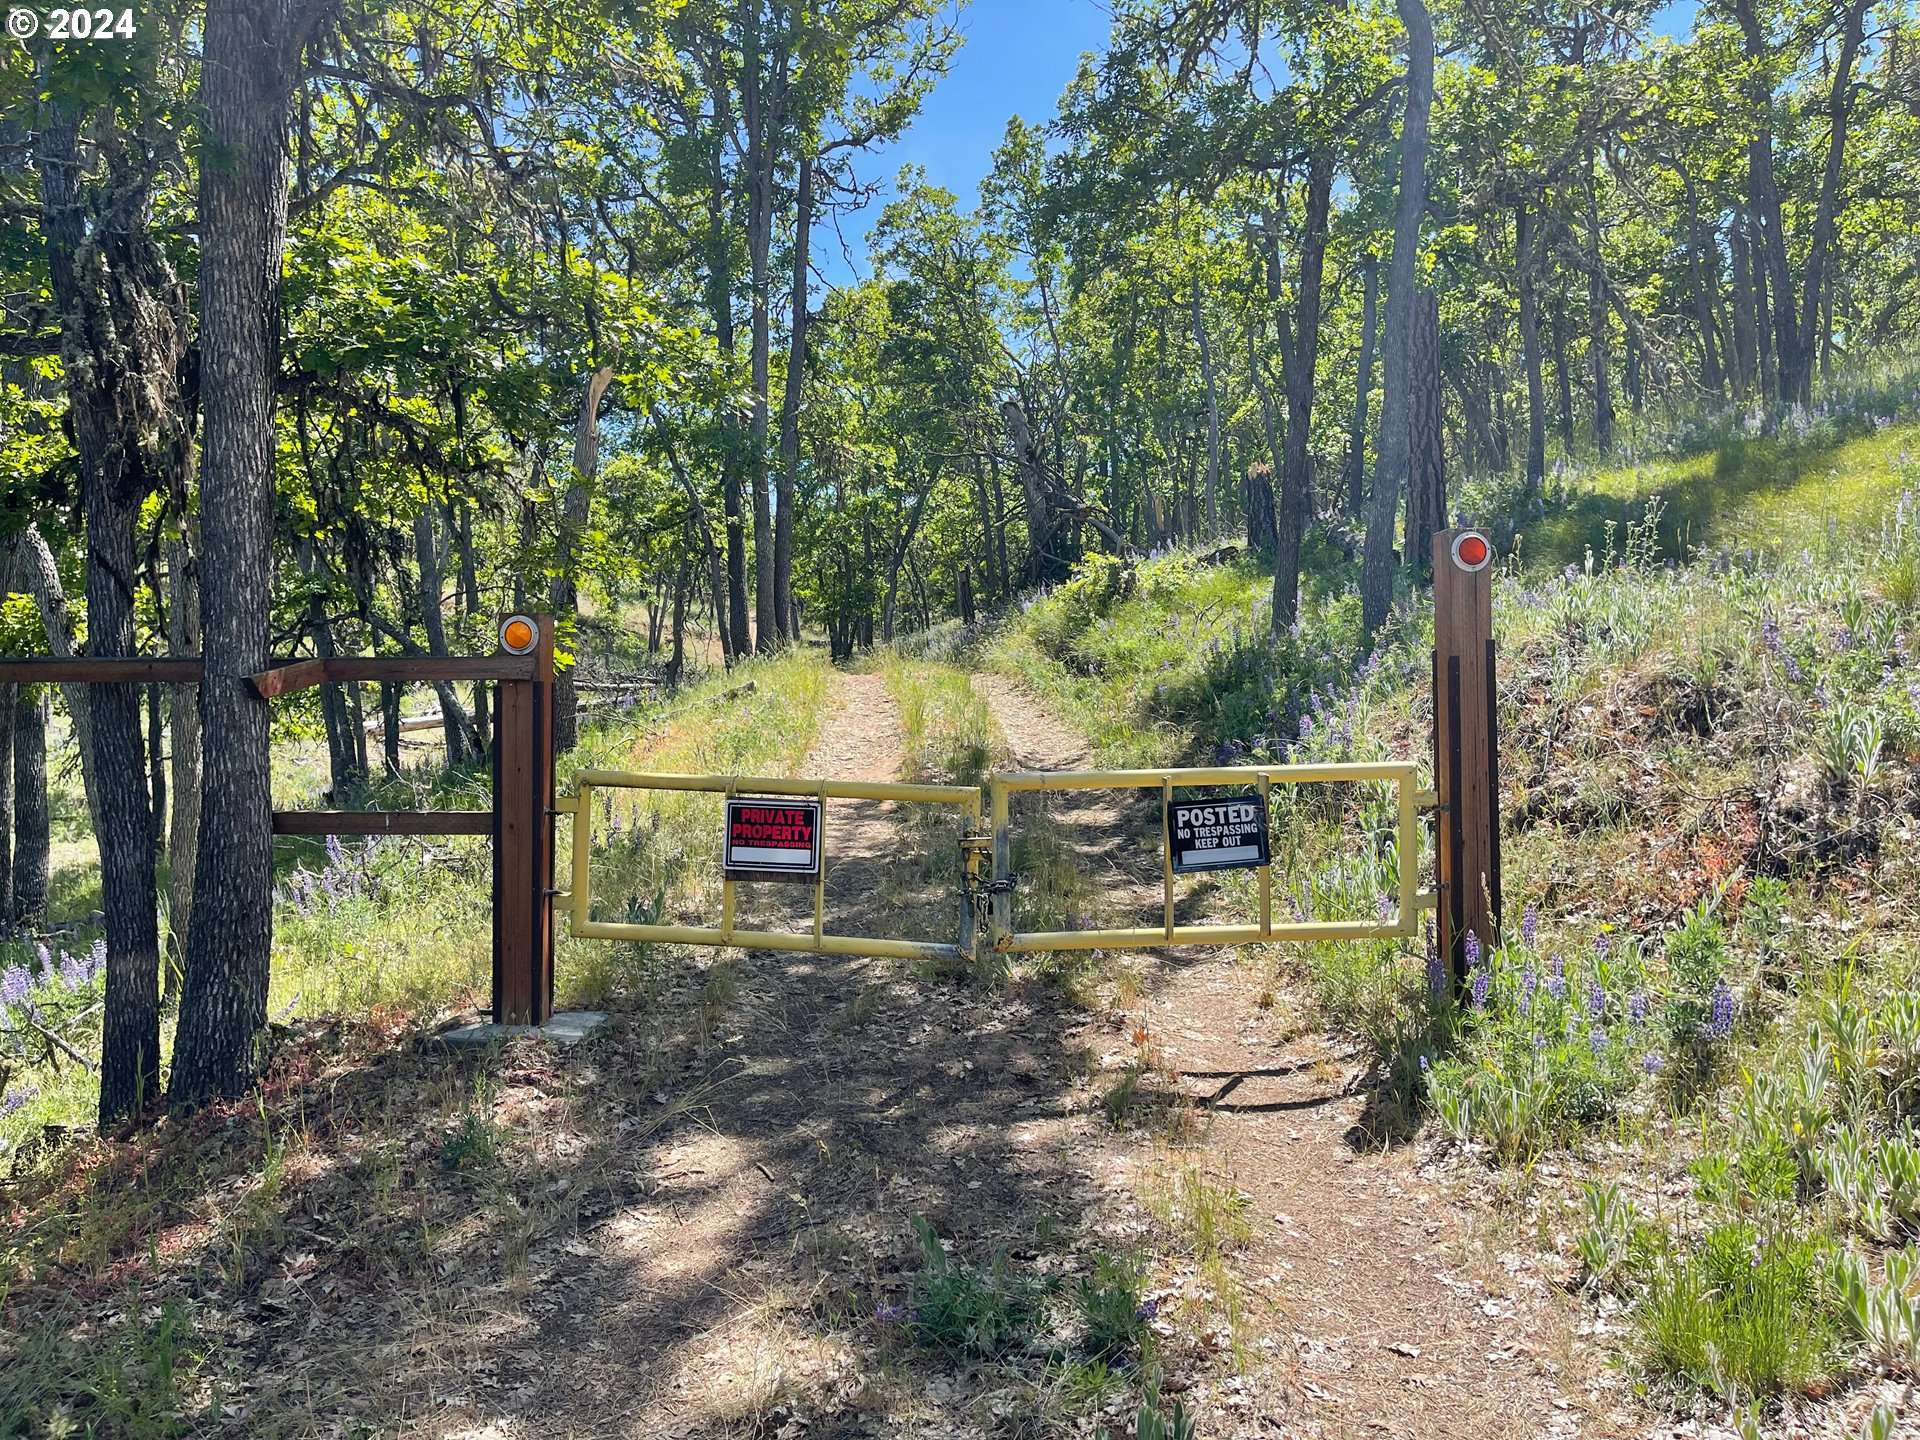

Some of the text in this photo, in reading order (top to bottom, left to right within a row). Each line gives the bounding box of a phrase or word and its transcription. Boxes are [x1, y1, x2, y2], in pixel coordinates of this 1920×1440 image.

[741, 809, 805, 825] PRIVATE
[1177, 805, 1254, 828] POSTED
[732, 824, 812, 841] PROPERTY
[1177, 823, 1258, 839] NO TRESPASSING
[749, 840, 812, 848] TRESPASSING
[1195, 835, 1241, 849] KEEP OUT
